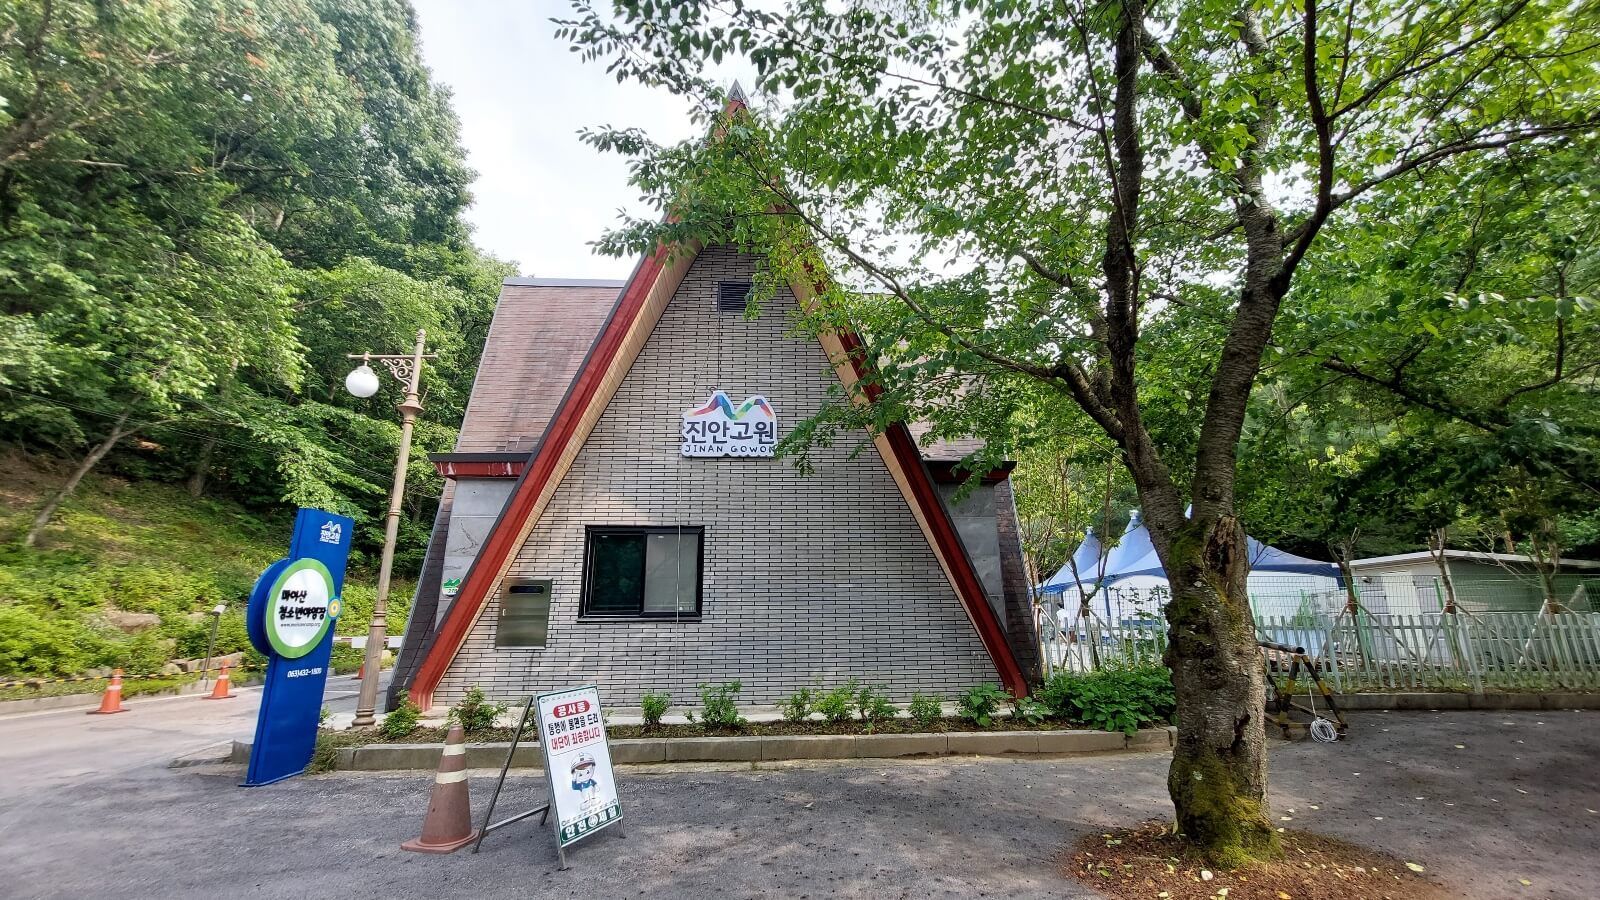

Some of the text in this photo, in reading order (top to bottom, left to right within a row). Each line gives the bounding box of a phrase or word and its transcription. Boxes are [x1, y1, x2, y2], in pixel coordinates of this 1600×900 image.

[686, 420, 774, 444] 진안고원
[684, 445, 775, 453] JINAN GOWON
[281, 590, 307, 603] 마이산
[278, 606, 326, 620] 청소년야영장
[557, 701, 586, 717] 공사중
[568, 715, 586, 731] 불편을
[551, 726, 601, 750] 대단히 죄송합니다
[565, 819, 587, 839] 안전
